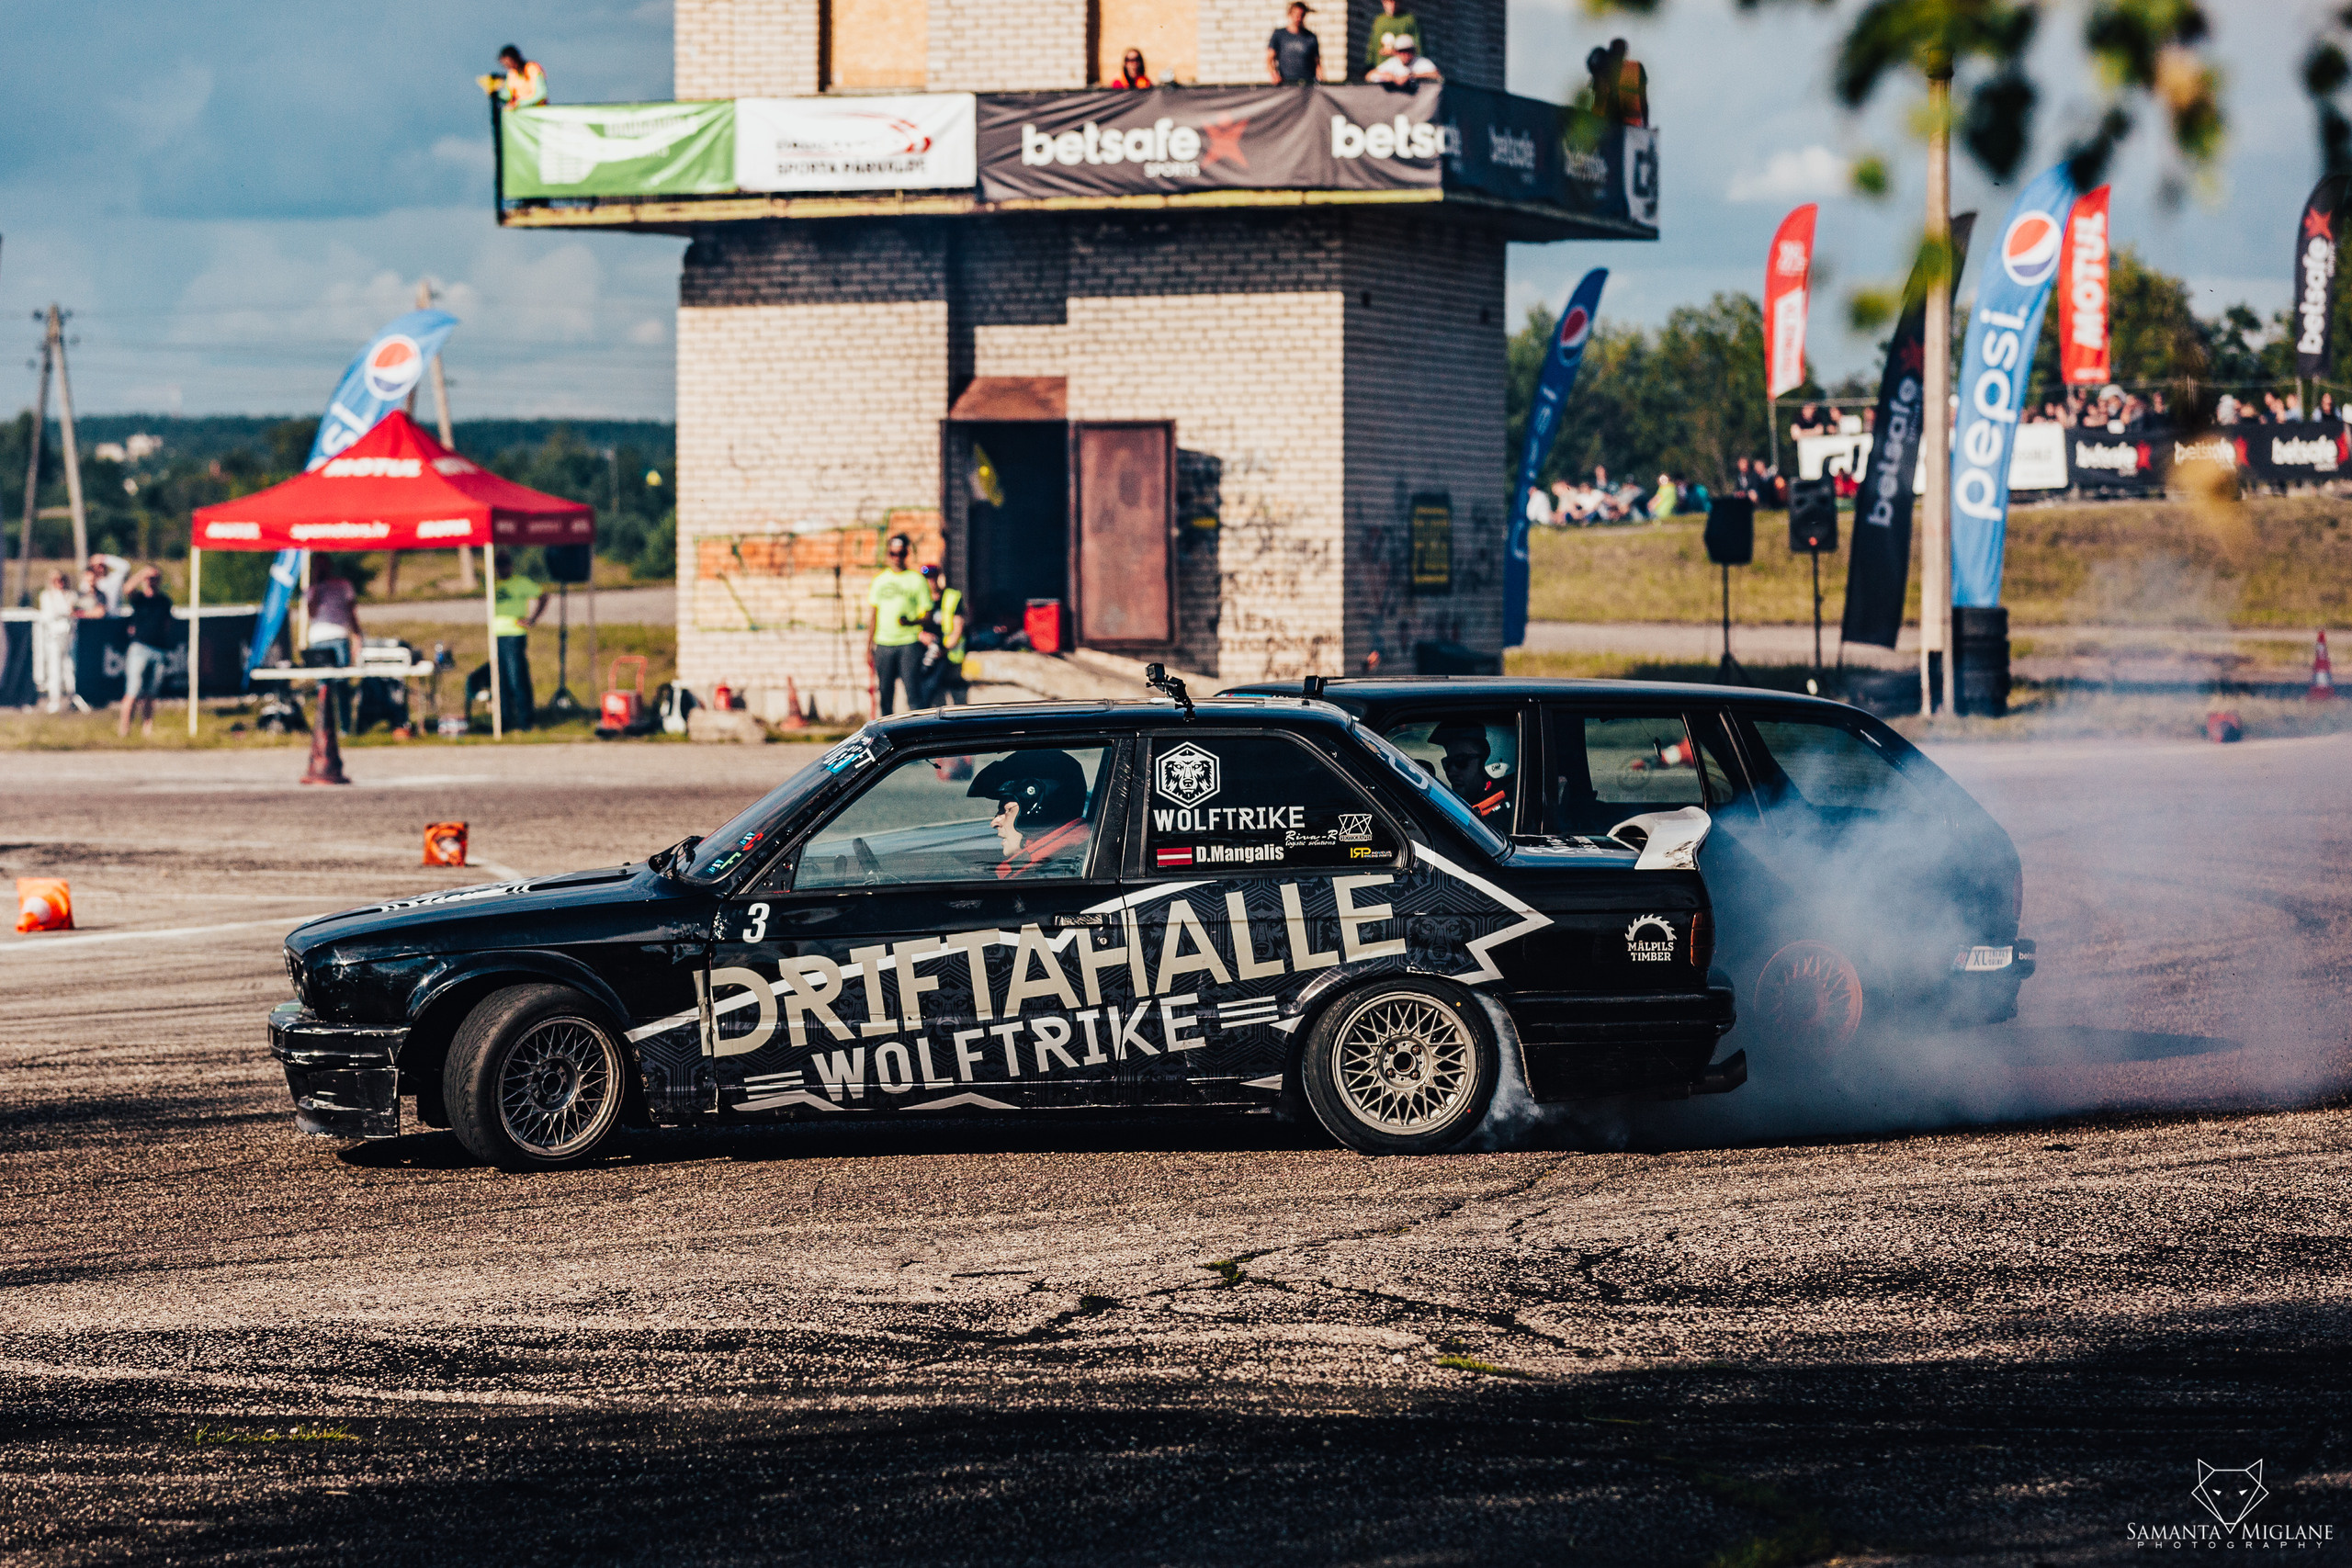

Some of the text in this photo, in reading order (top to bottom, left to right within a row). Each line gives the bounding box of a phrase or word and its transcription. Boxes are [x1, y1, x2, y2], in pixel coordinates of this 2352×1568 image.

[1022, 117, 1201, 166] betsafe
[2071, 211, 2106, 350] MOTUL
[2297, 236, 2329, 355] betsafe
[1955, 306, 2029, 522] pepsi
[1866, 376, 1917, 528] betsafe
[2075, 439, 2139, 469] betsafe
[2271, 434, 2338, 466] betsafe
[1153, 806, 1306, 831] WOLFTRIKE
[1196, 843, 1284, 863] D.Mangalis
[742, 902, 770, 943] 3
[692, 874, 1408, 1058] DRIFTAHALLE
[1631, 952, 1671, 962] TIMBER
[1973, 949, 1988, 966] XL
[811, 992, 1207, 1102] WOLFTRIKE
